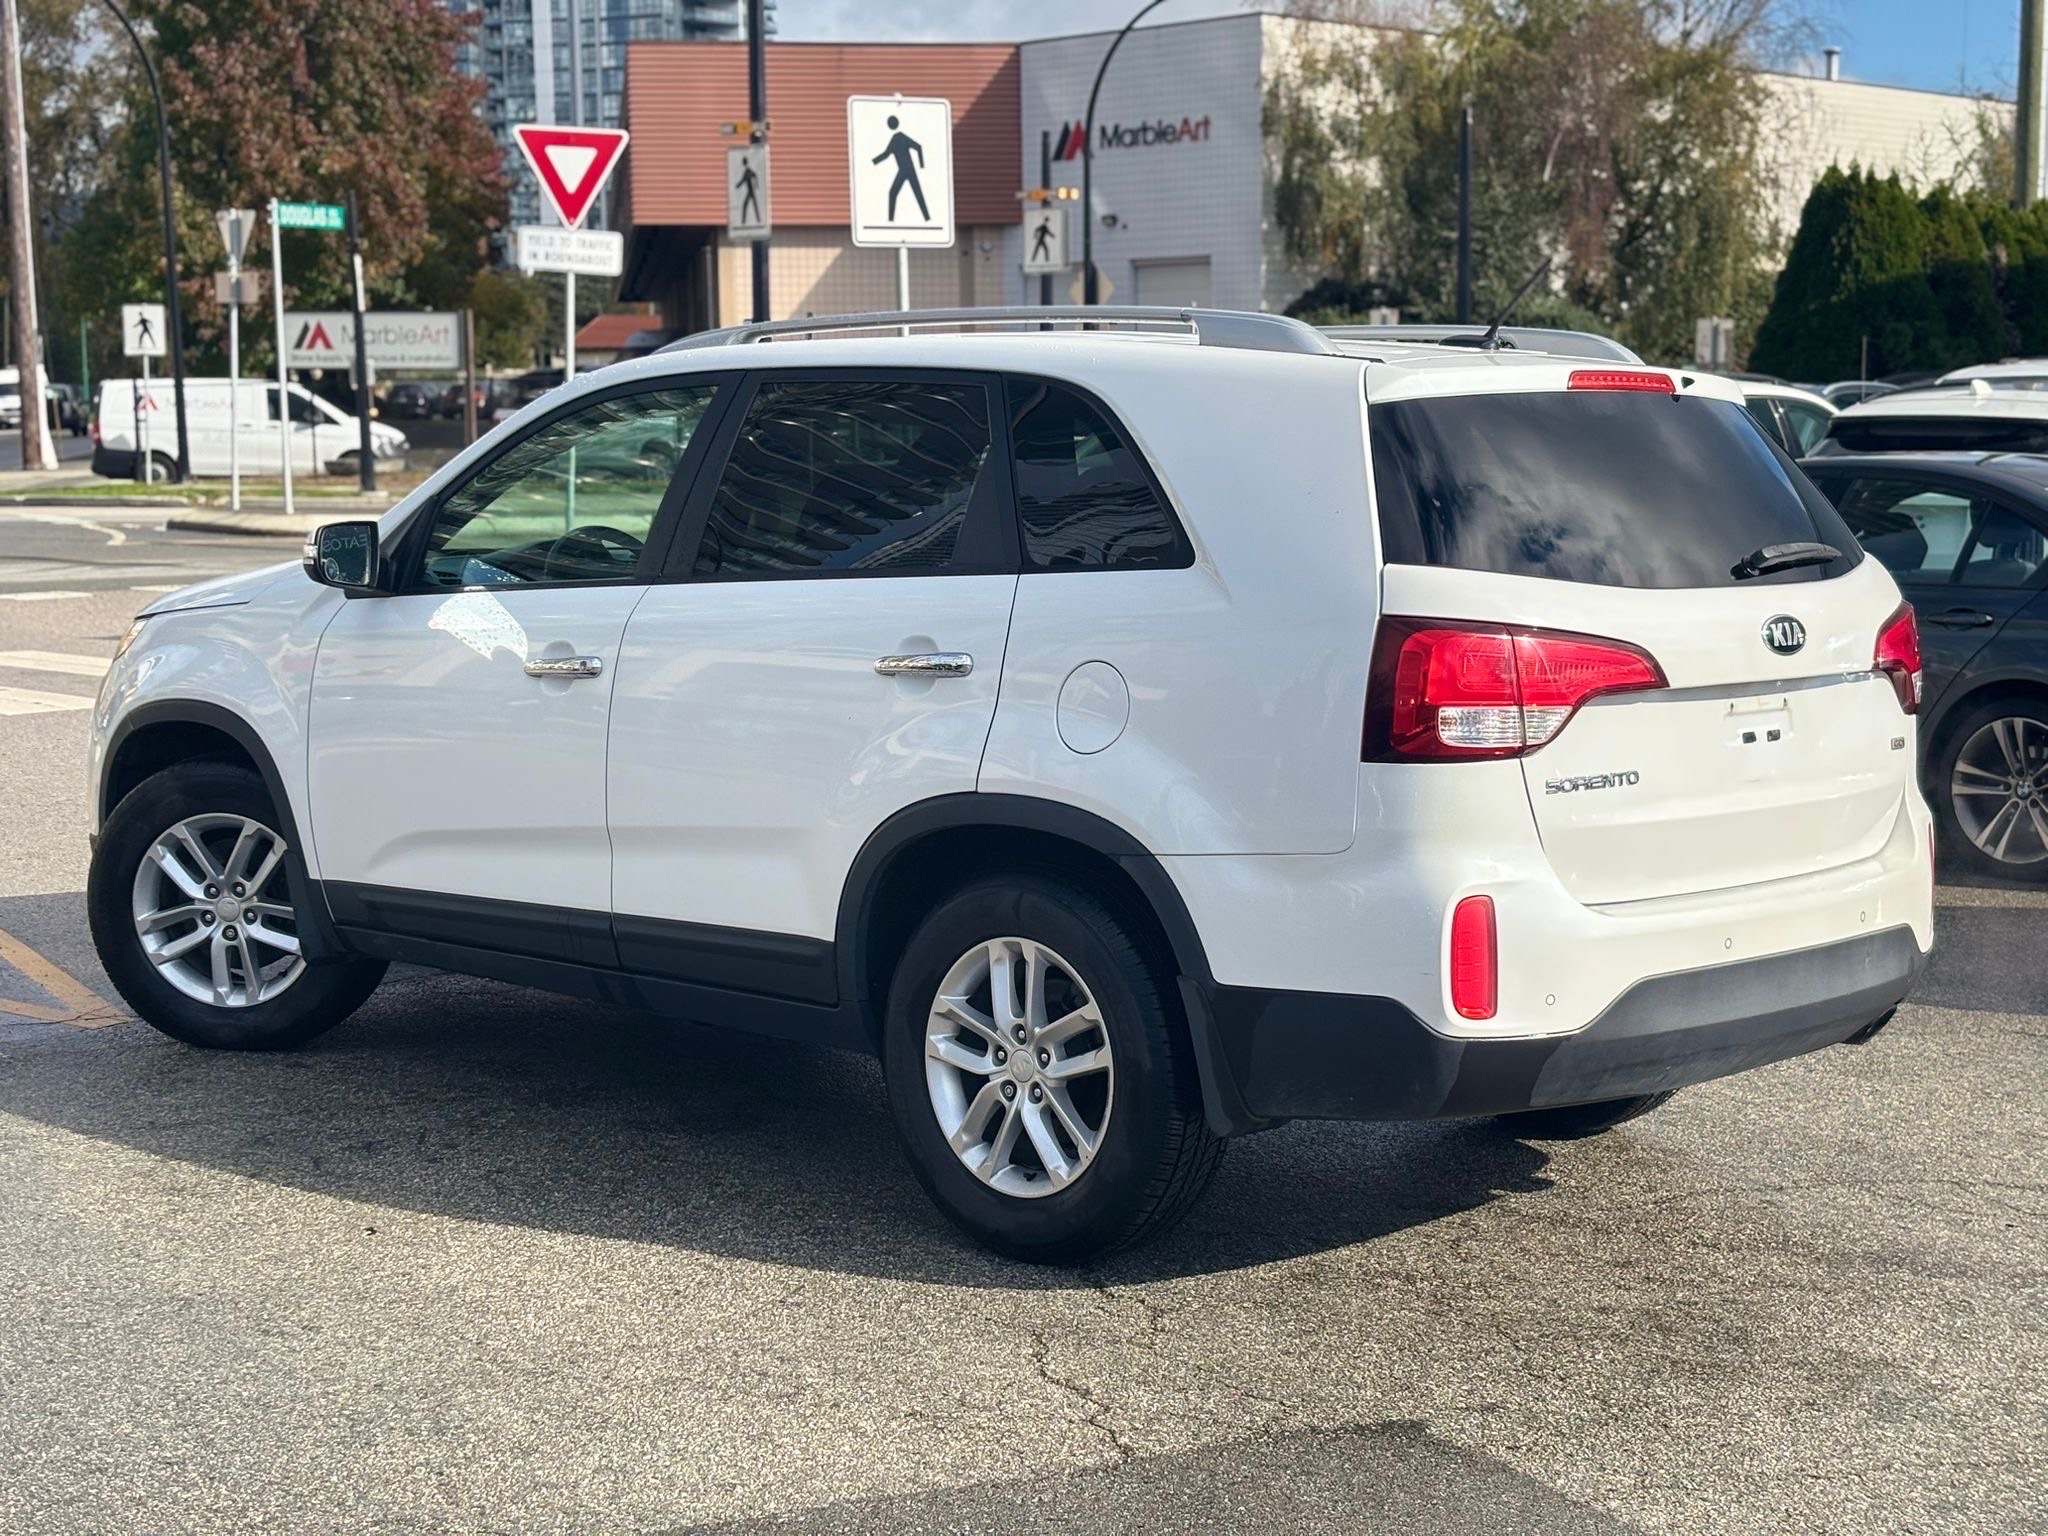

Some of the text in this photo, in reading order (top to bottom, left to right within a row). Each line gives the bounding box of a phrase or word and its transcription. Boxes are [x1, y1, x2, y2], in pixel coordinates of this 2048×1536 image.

[1100, 115, 1210, 149] MarbleArt
[280, 205, 327, 226] DOUGLAS
[577, 237, 615, 252] TRAFFIC
[544, 250, 614, 266] ROUNDABOUT
[1769, 621, 1804, 647] KIA
[1545, 770, 1640, 795] SORENTO
